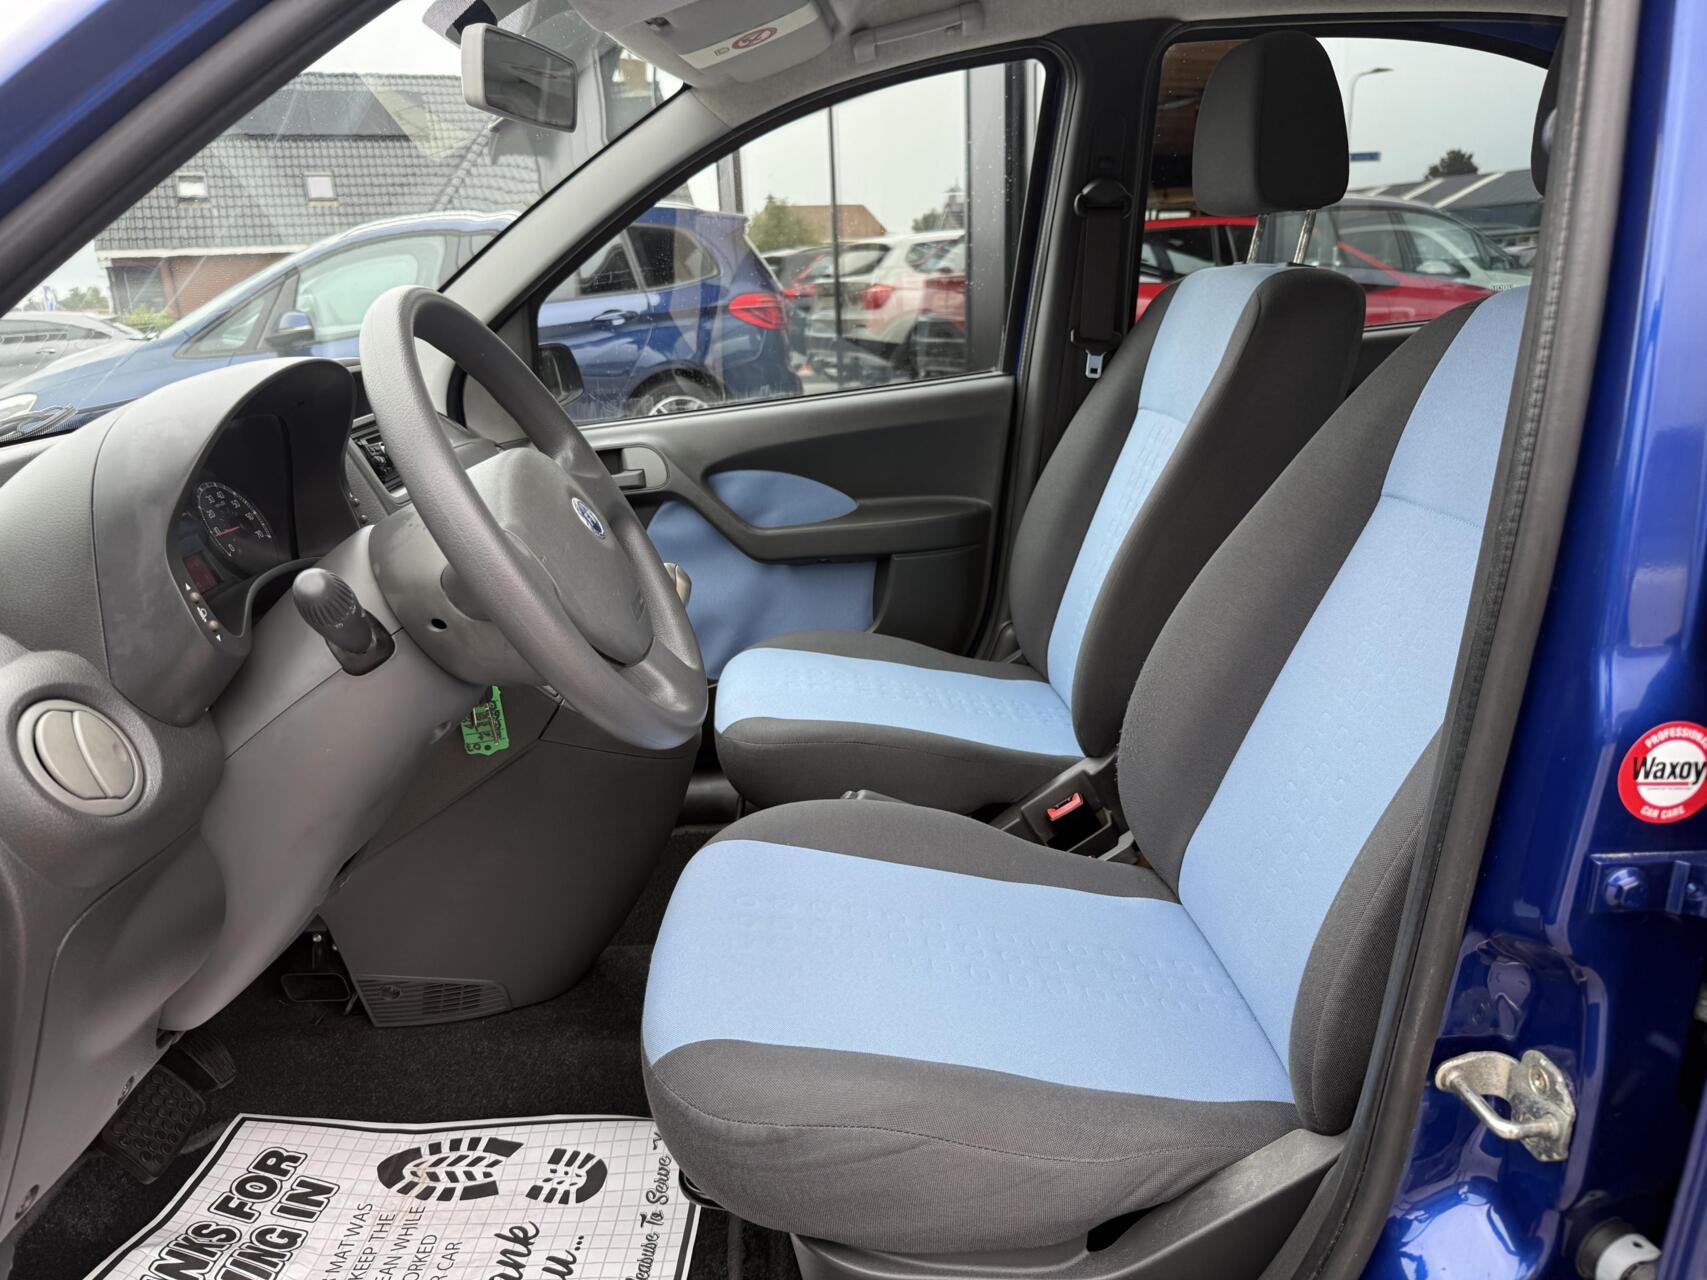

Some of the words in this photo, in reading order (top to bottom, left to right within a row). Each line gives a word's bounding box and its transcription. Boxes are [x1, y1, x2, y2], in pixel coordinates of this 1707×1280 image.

[270, 1175, 340, 1223] IN
[645, 1154, 672, 1206] Serve
[140, 1221, 243, 1280] NKS
[208, 1147, 308, 1224] FOR
[325, 1240, 355, 1273] MAT
[344, 1203, 373, 1238] WAS
[390, 1206, 426, 1252] WHILE
[640, 1209, 665, 1229] To
[347, 1246, 378, 1280] KEEP
[368, 1213, 396, 1242] THE
[436, 1241, 463, 1271] CAR
